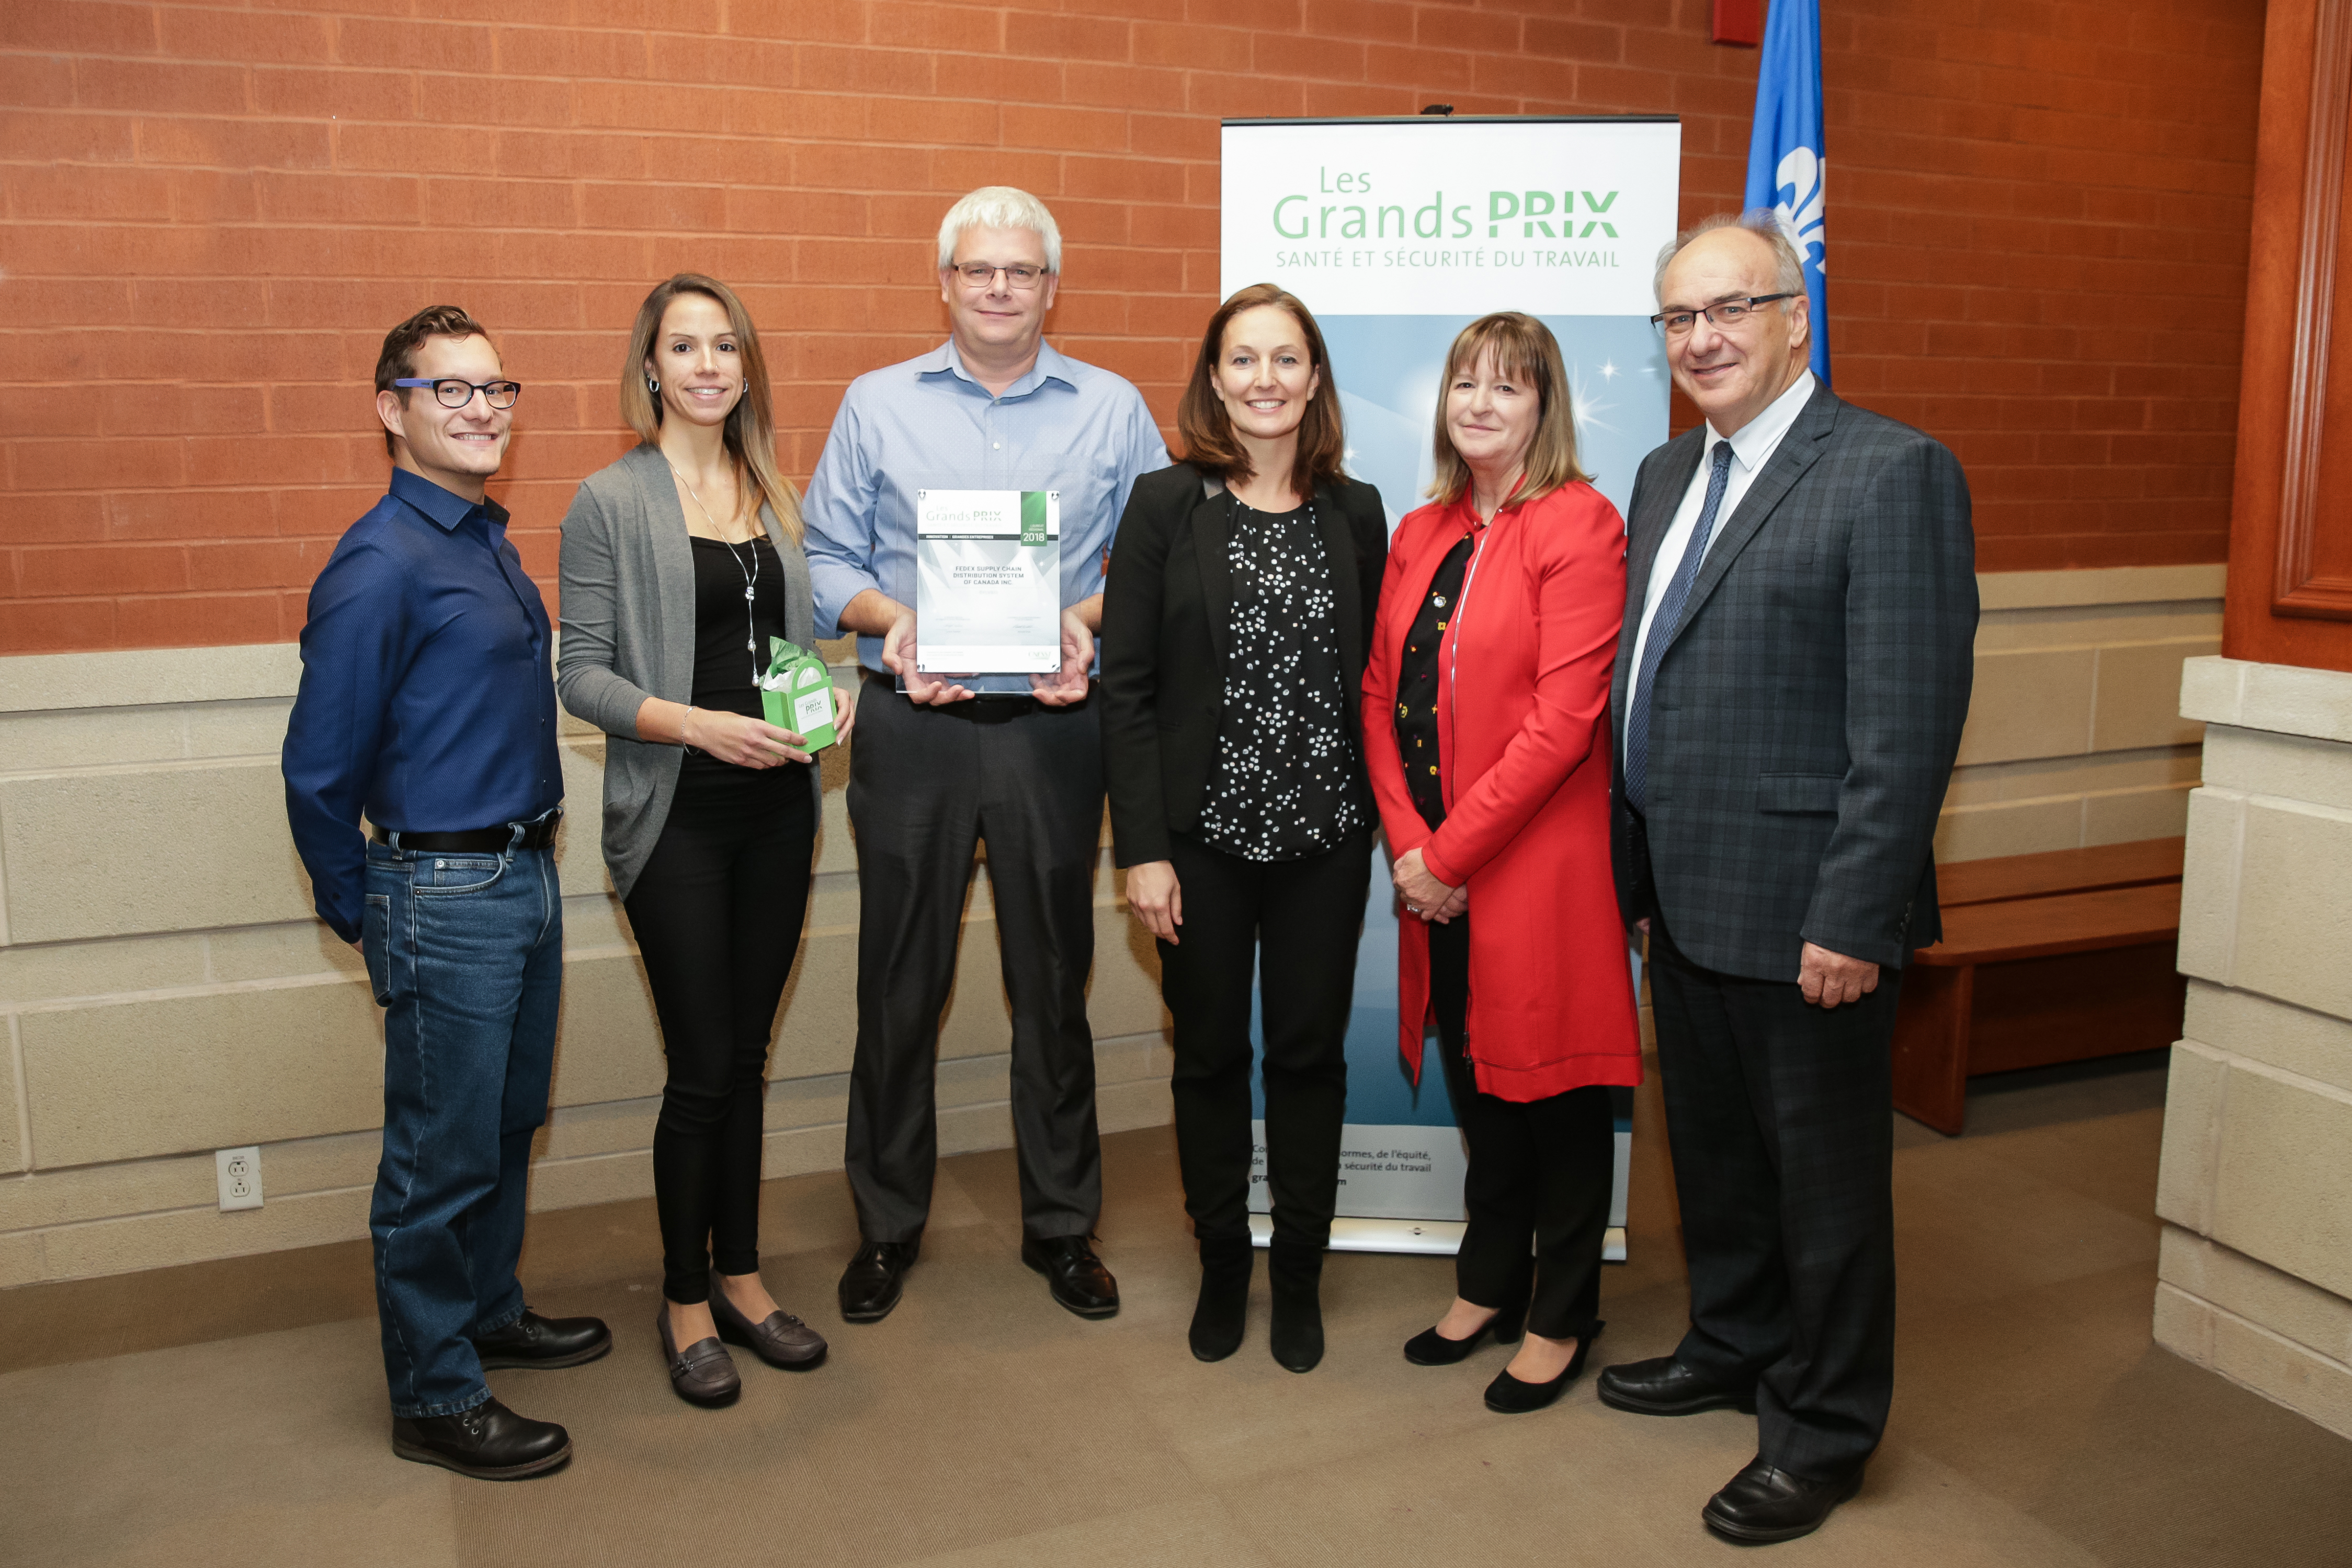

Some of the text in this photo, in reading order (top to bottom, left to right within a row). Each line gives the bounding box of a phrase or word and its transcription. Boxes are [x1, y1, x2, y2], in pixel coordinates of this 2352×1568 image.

[1321, 166, 1371, 193] Les
[1273, 191, 1619, 239] Grands PRIX
[1277, 246, 1619, 267] SANTÉ ET SÉCURITÉ DU TRAVAIL
[926, 510, 1002, 521] Grands PRIX
[1023, 532, 1045, 542] 2018
[806, 700, 822, 715] PRIX
[1340, 1150, 1374, 1159] ormes,
[1377, 1150, 1389, 1158] de
[1252, 1157, 1264, 1165] de
[1345, 1161, 1383, 1171] sécurité
[1385, 1162, 1398, 1171] du
[1401, 1163, 1431, 1172] travail
